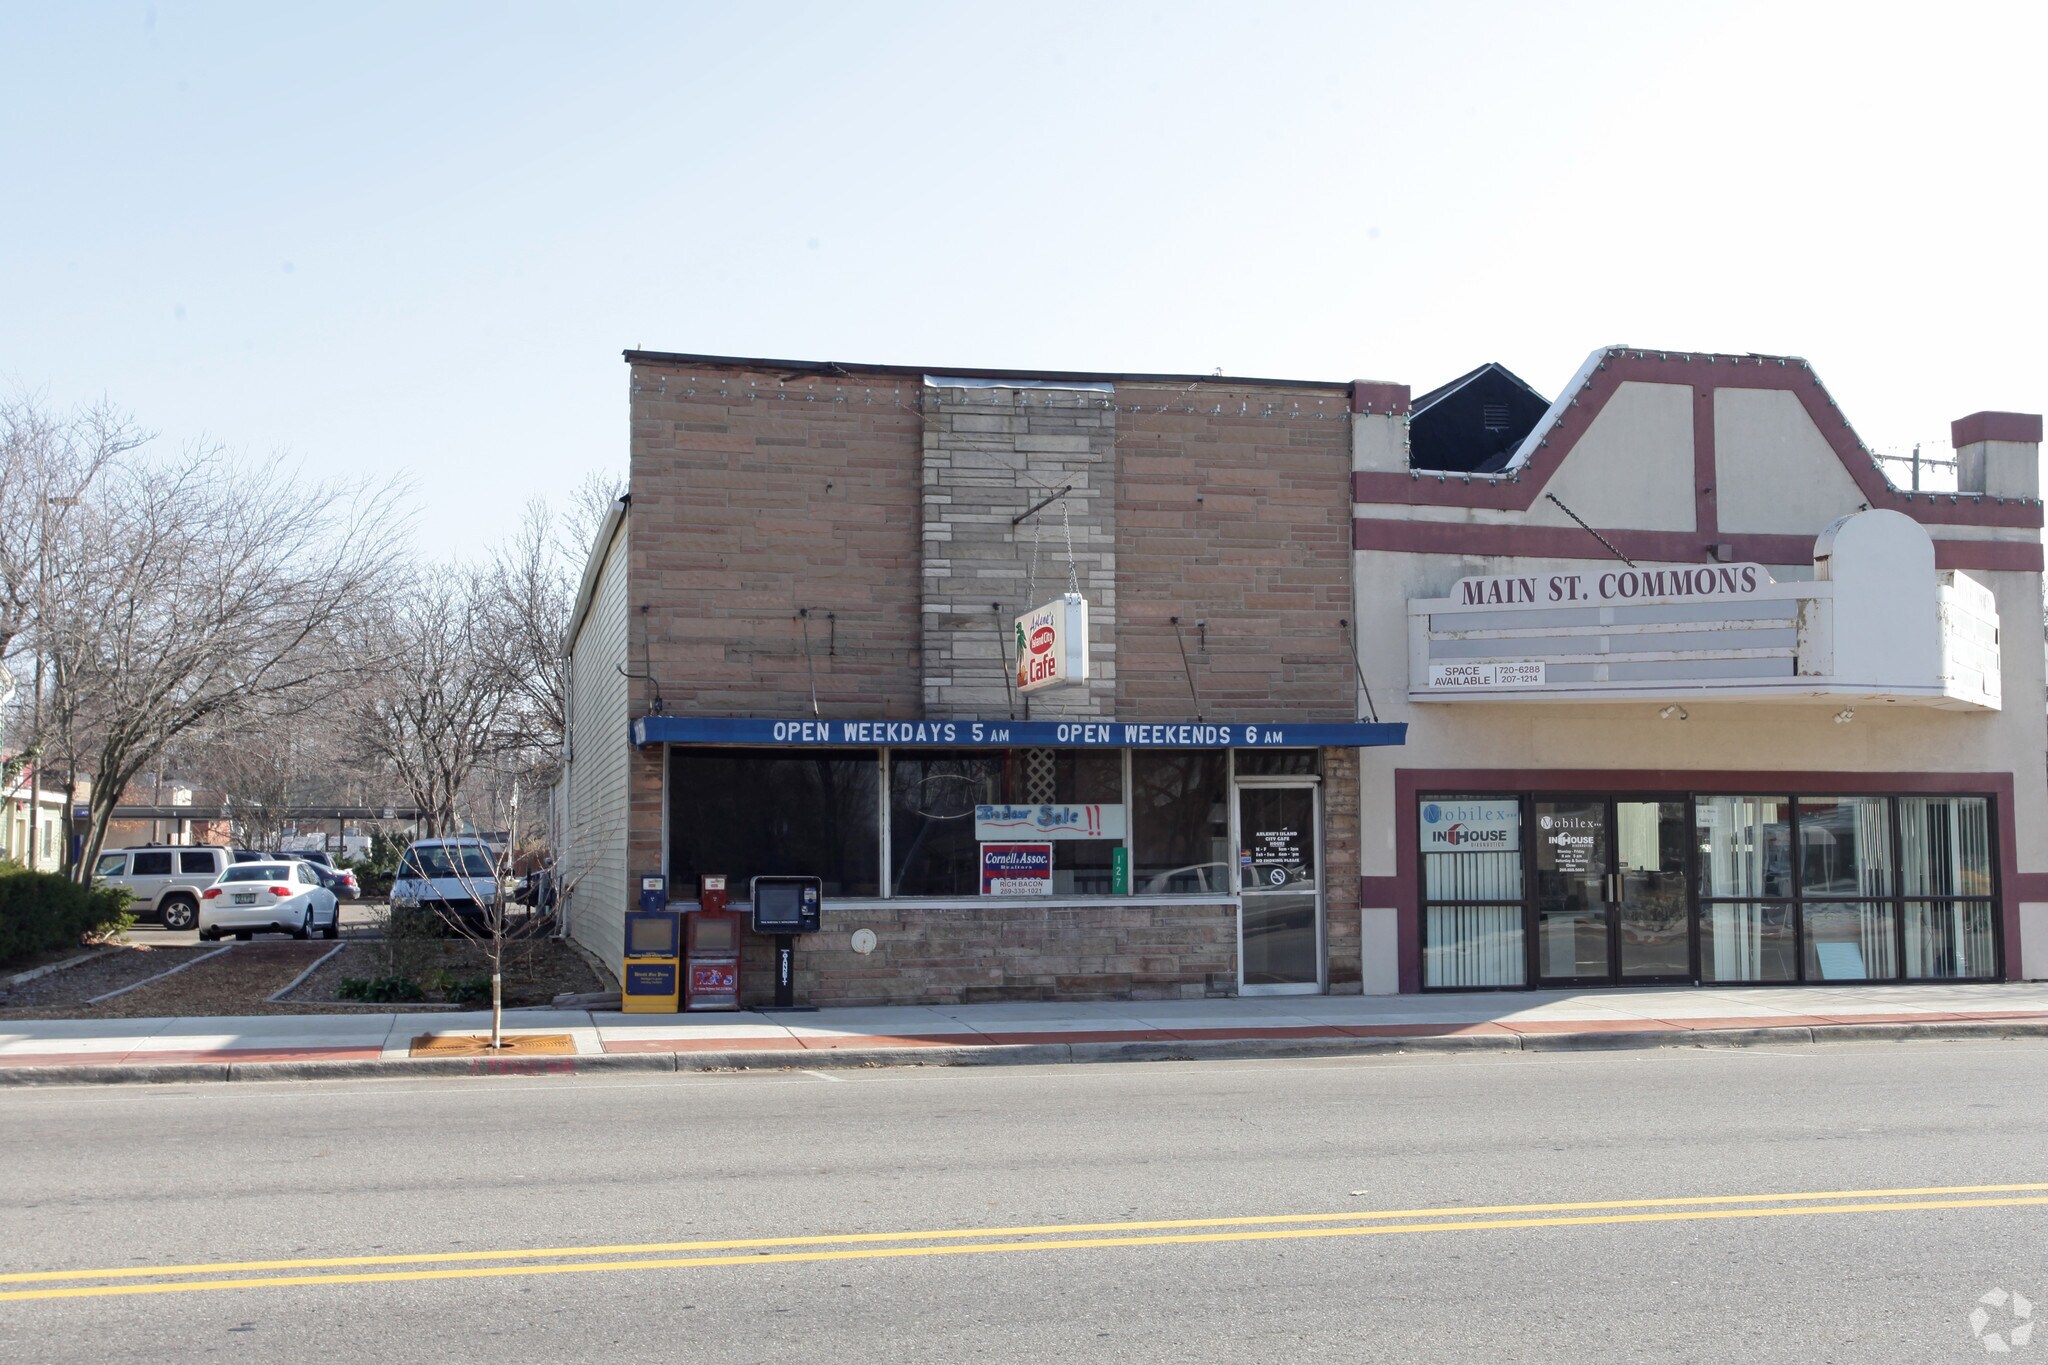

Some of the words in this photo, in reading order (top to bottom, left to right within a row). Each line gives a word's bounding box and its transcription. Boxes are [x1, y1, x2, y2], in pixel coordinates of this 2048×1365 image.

[1462, 577, 1537, 605] MAIN
[1549, 575, 1588, 601] ST.
[1598, 566, 1757, 599] COMMONS
[1032, 635, 1044, 648] Island
[1043, 632, 1053, 645] City
[1445, 666, 1480, 676] SPACE
[1499, 665, 1541, 675] 720-6288
[1434, 676, 1491, 686] AVAILABLE
[1501, 675, 1538, 683] 207-1214
[773, 722, 830, 742] OPEN
[844, 722, 956, 742] WEEKDAYS
[971, 723, 984, 742] 5
[990, 729, 1010, 742] AM
[1056, 724, 1110, 743] OPEN
[1125, 725, 1231, 744] WEEKENDS
[1245, 726, 1258, 744] 6
[1264, 731, 1283, 744] AM
[1036, 804, 1079, 827] Sale
[1424, 804, 1505, 823] Mobilex
[1541, 816, 1594, 829] Mobilex
[985, 852, 1017, 865] Cornell
[1019, 852, 1048, 865] Assoc.
